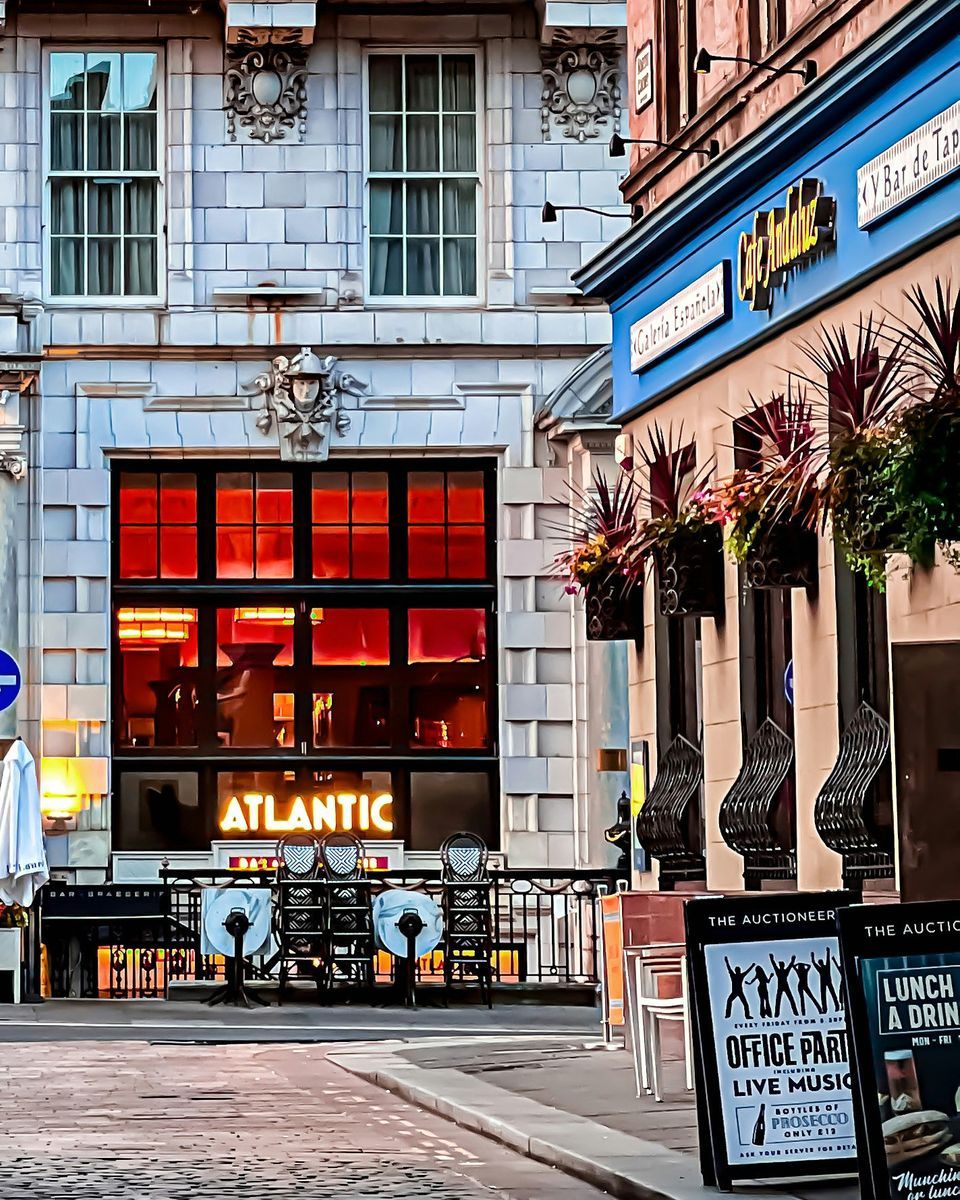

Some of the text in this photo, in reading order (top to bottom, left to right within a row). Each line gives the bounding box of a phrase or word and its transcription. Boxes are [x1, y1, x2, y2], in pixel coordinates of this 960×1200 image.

[884, 164, 907, 198] Bar
[913, 143, 929, 179] de
[763, 177, 821, 289] Andaluz
[219, 793, 394, 832] ATLANTIC
[708, 915, 737, 927] THE
[864, 925, 896, 937] THE
[883, 973, 954, 1003] LUNCH
[761, 1020, 790, 1028] FRIDAY
[888, 1005, 903, 1031] A
[911, 1036, 931, 1047] MON
[938, 1035, 952, 1045] FRI
[726, 1032, 797, 1069] OFFICE
[773, 1067, 816, 1075] INCLUDING
[733, 1072, 853, 1097] LIVE MUSIC
[775, 1103, 839, 1116] BOTTLES OF
[771, 1112, 850, 1130] PROSECCO
[784, 1129, 812, 1138] ONLY
[785, 1147, 814, 1155] SERVER
